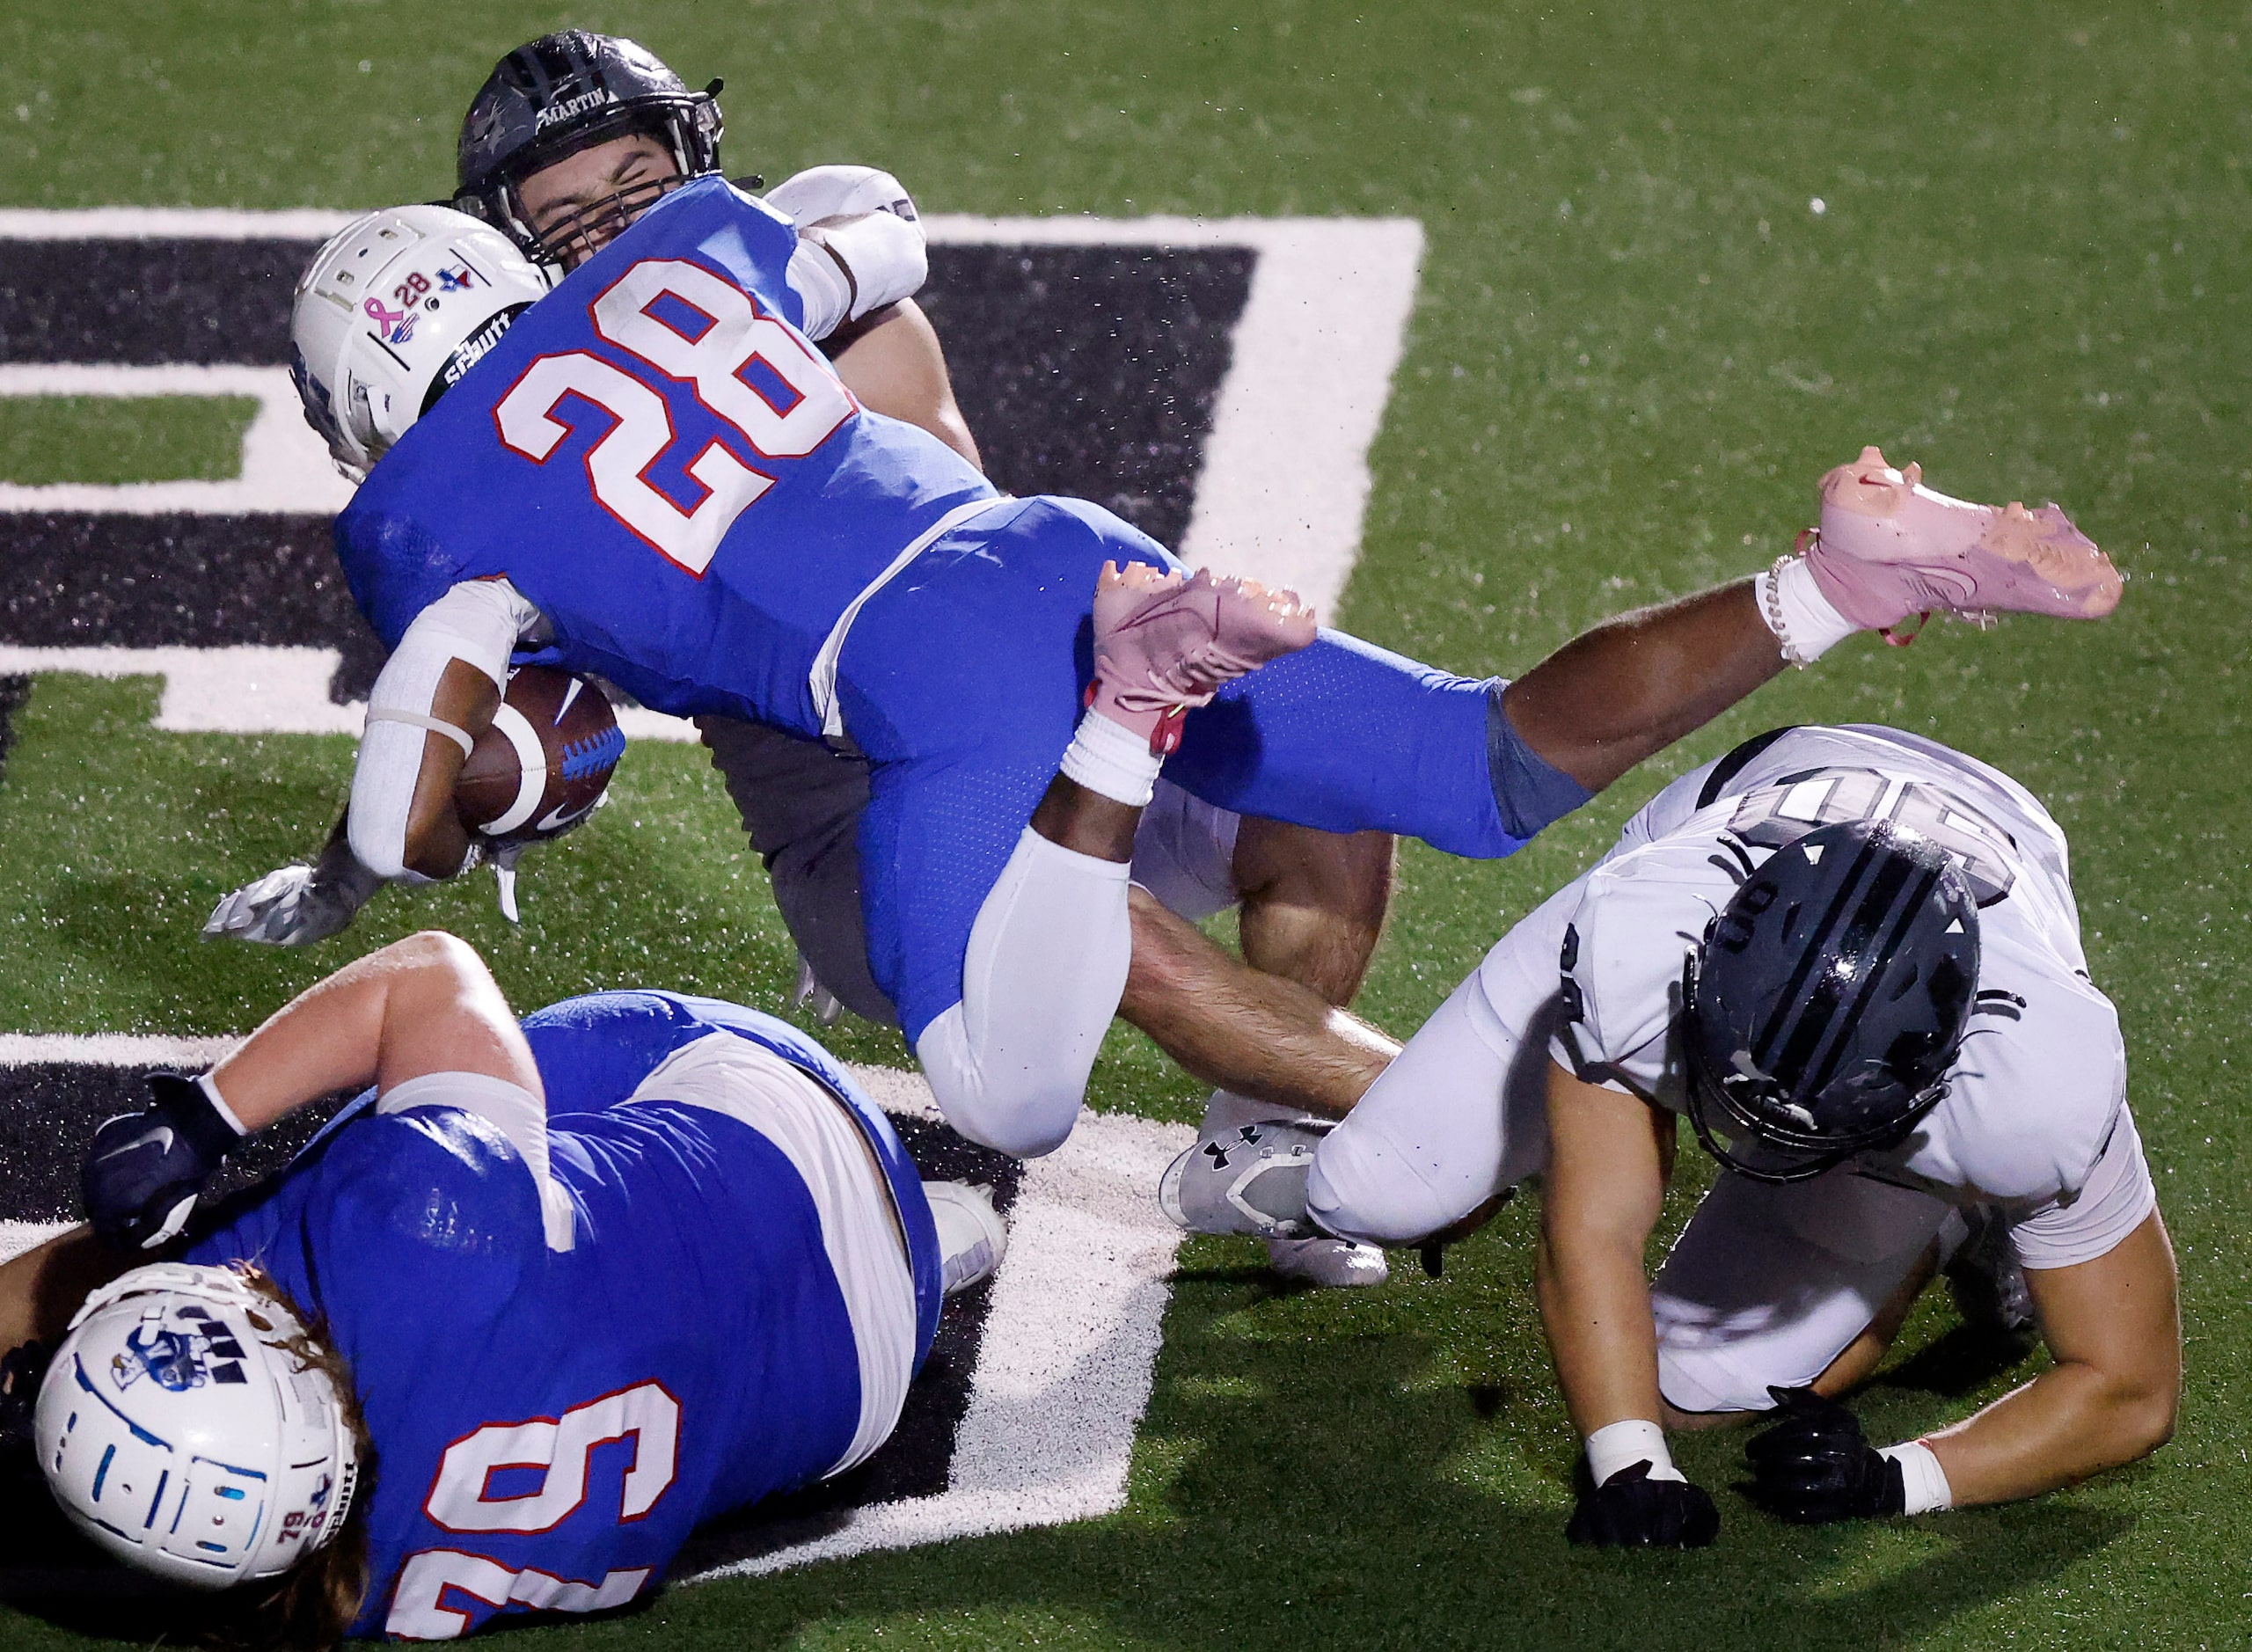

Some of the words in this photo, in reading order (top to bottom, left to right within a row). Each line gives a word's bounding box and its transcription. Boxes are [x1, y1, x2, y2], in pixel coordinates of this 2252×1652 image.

[542, 87, 605, 126] MARTIN
[395, 272, 431, 309] 28
[490, 258, 859, 581] 28
[277, 1510, 304, 1545] 79
[386, 1378, 683, 1641] 79
